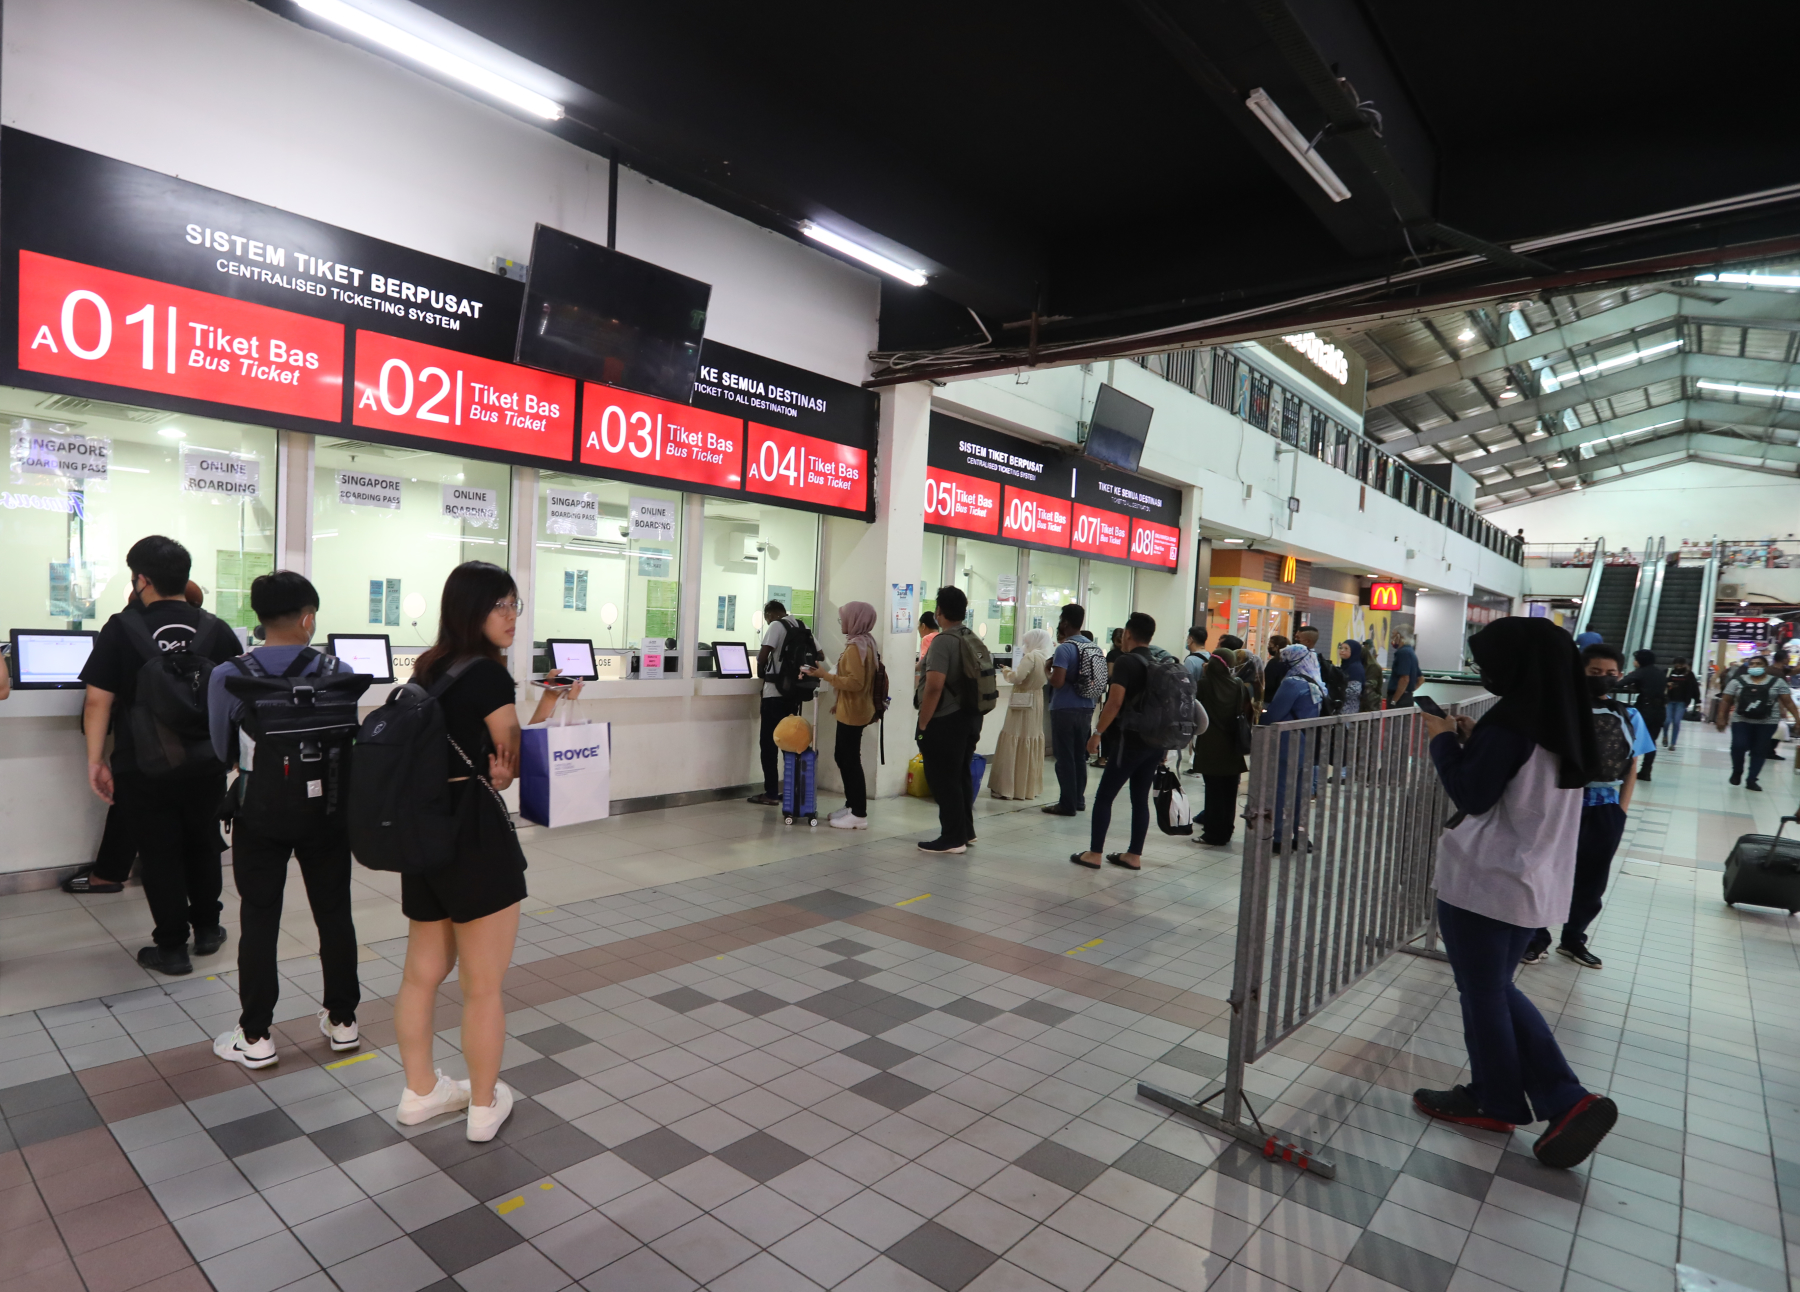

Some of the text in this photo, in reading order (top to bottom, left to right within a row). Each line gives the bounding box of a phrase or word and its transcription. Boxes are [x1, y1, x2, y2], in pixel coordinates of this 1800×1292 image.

[186, 224, 483, 318] SISTEM TIKET BERPUSAT
[216, 259, 460, 331] CENTRALISED TICKETING SYSTEM
[188, 322, 319, 369] Tiket Bas
[188, 349, 300, 386] Bus Ticket
[700, 365, 827, 412] KE SEMUA DESTINASI
[470, 382, 560, 418] Tiket Bas
[694, 382, 798, 417] TICKET TO ALL DESTINATION
[469, 404, 547, 432] Bus Ticket
[667, 424, 733, 452] Tiket Bas
[666, 442, 723, 464] Bus Ticket
[959, 440, 1044, 473] SISTEM TIKET BERPUSAT
[81, 463, 107, 473] PASS
[199, 460, 246, 475] ONLINE
[808, 455, 859, 479] Tiket Bas
[966, 456, 998, 471] CENTRALISED
[188, 477, 256, 494] BOARDING
[341, 475, 400, 491] SINGAPORE
[807, 472, 851, 490] Bus Ticket
[382, 495, 400, 504] PASS
[453, 489, 487, 501] ONLINE
[956, 489, 993, 508] Tiket Bas
[1098, 481, 1113, 493] TIKET
[1113, 485, 1121, 496] KE
[1121, 488, 1138, 501] SEMUA
[1139, 493, 1163, 507] DESTINASI
[445, 504, 493, 518] BOARDING
[551, 496, 595, 510] SINGAPORE
[955, 503, 987, 517] Bus Ticket
[551, 510, 595, 521] BOARDING PASS
[640, 506, 666, 517] ONLINE
[1037, 508, 1066, 524] Tiket Bas
[635, 520, 671, 530] BOARDING
[1037, 520, 1062, 533] Bus Ticket
[1101, 523, 1125, 537] Tiket Bas
[1100, 534, 1122, 545] Bus Ticket
